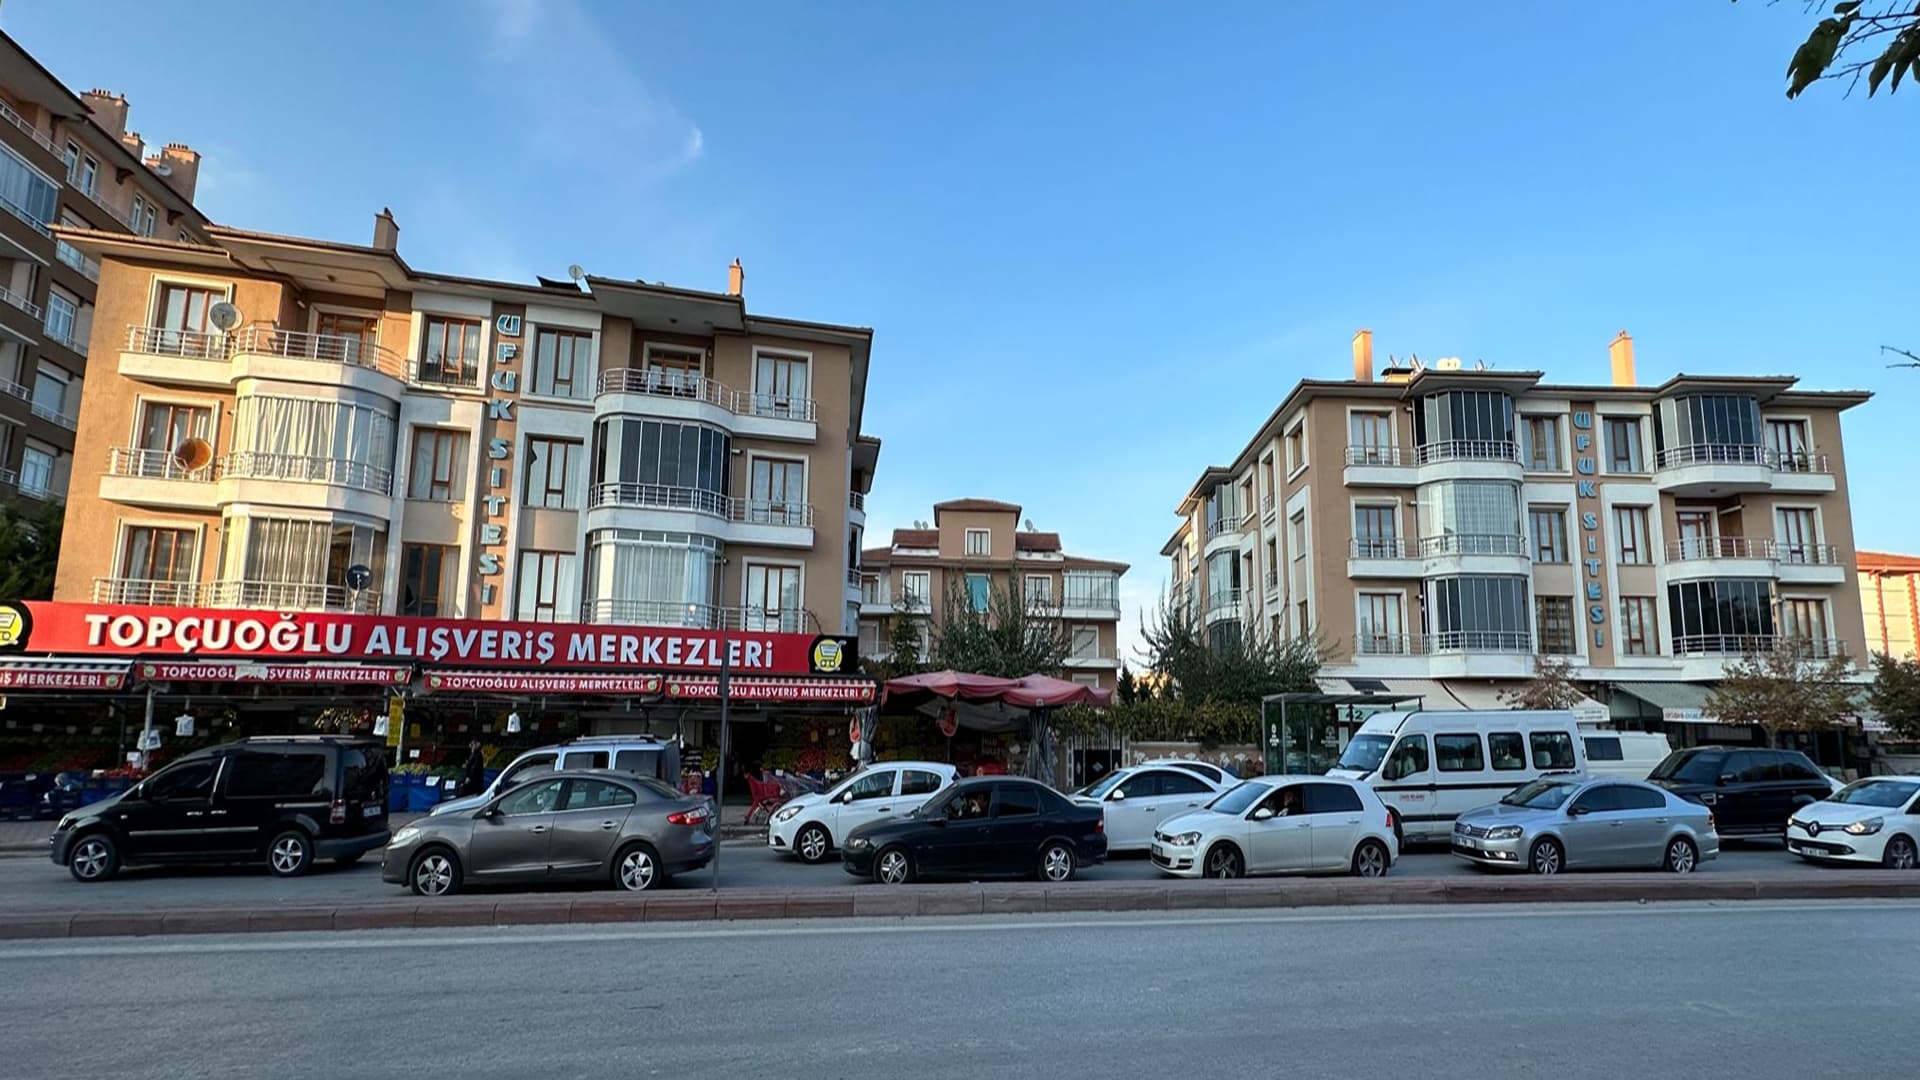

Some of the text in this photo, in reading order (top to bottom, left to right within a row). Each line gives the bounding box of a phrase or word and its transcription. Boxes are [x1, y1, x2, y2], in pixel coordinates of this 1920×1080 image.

[491, 314, 520, 420] UFUK
[1574, 411, 1596, 498] UFUK
[85, 613, 353, 654] TOPÇUOĞLU
[162, 666, 235, 679] TOPÇUOĞL
[446, 676, 518, 689] TOPÇUOĞLU
